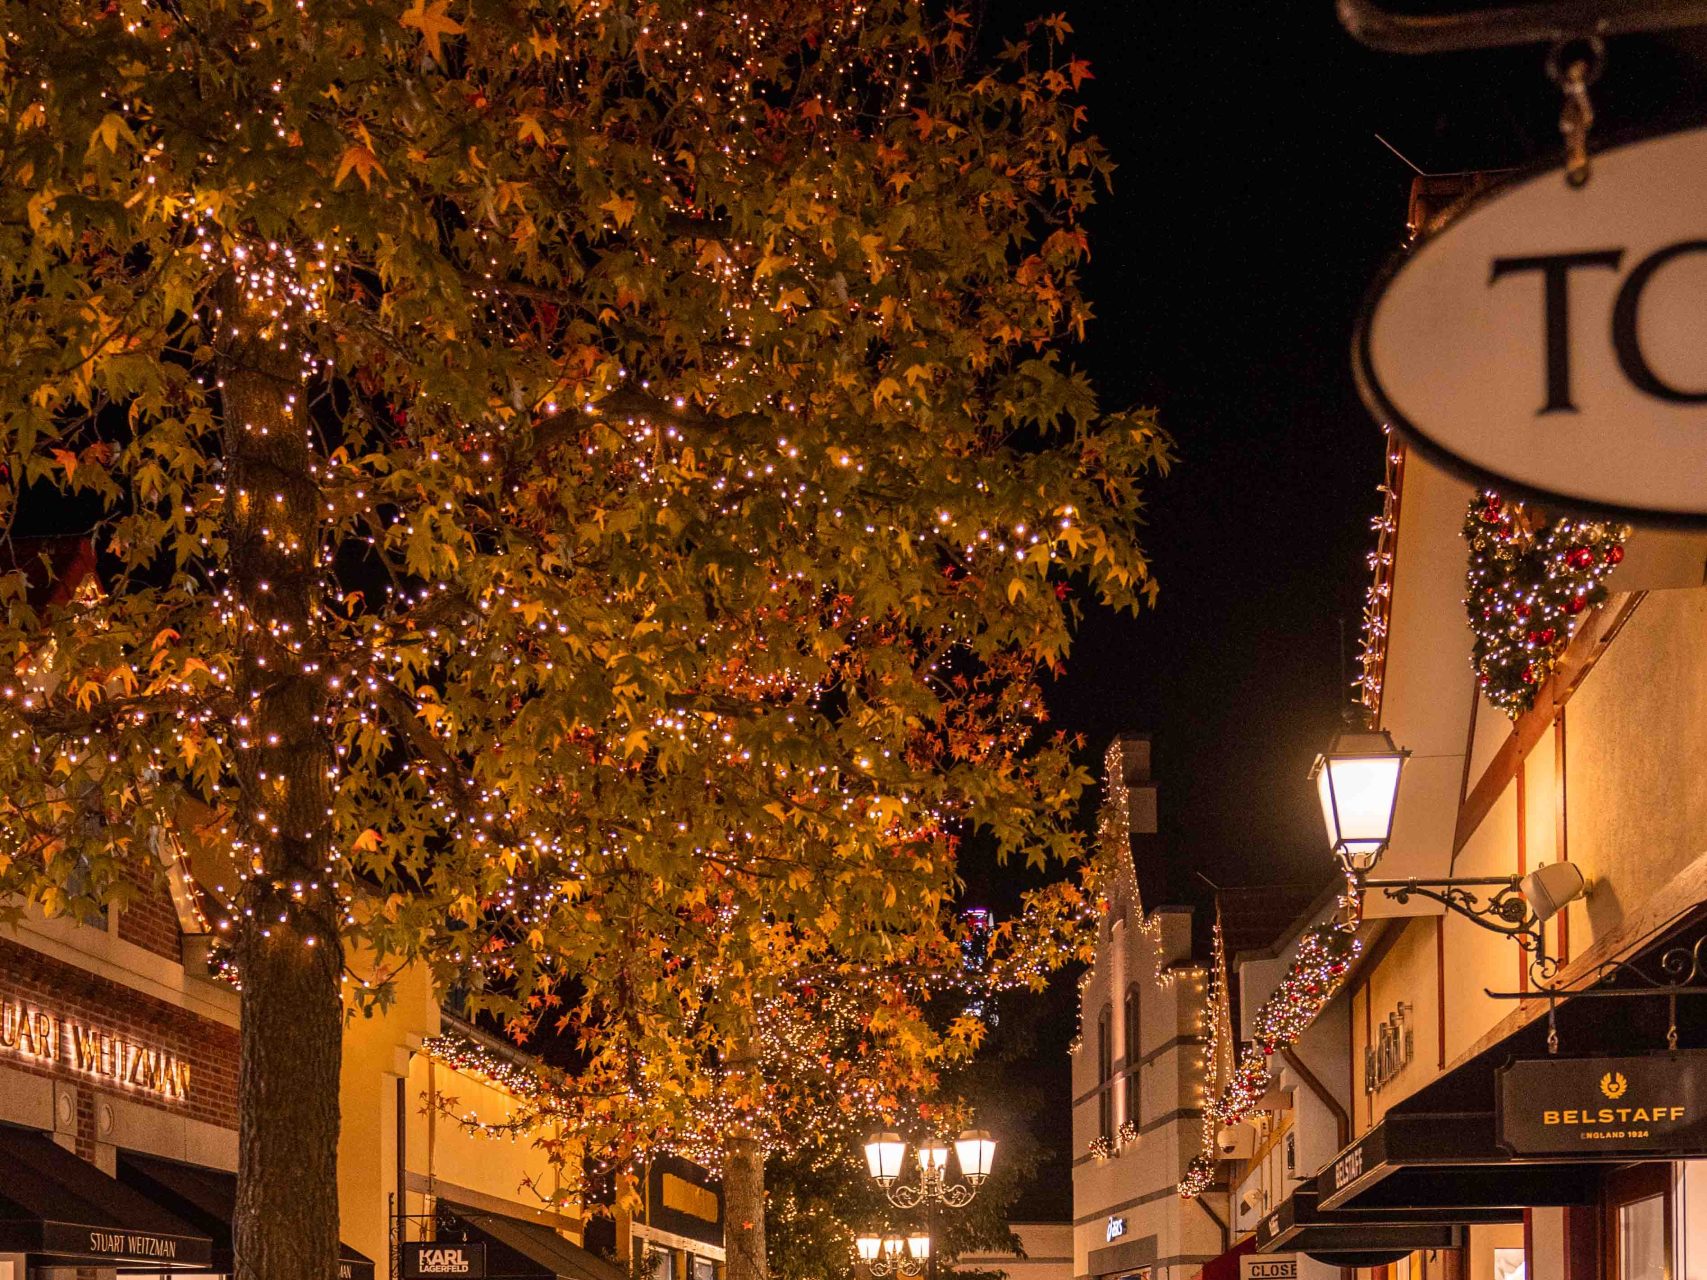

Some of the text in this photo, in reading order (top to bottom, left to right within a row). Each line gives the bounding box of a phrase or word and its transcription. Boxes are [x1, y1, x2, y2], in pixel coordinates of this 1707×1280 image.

[72, 1025, 191, 1101] WEITZMAN
[1544, 1107, 1685, 1124] BELSTAFF
[1628, 1130, 1649, 1138] 1924
[1335, 1147, 1363, 1189] BELSTAFF
[90, 1232, 176, 1258] STUART WEITZMAN
[419, 1249, 468, 1266] KARL
[419, 1265, 469, 1273] LAGERFELD
